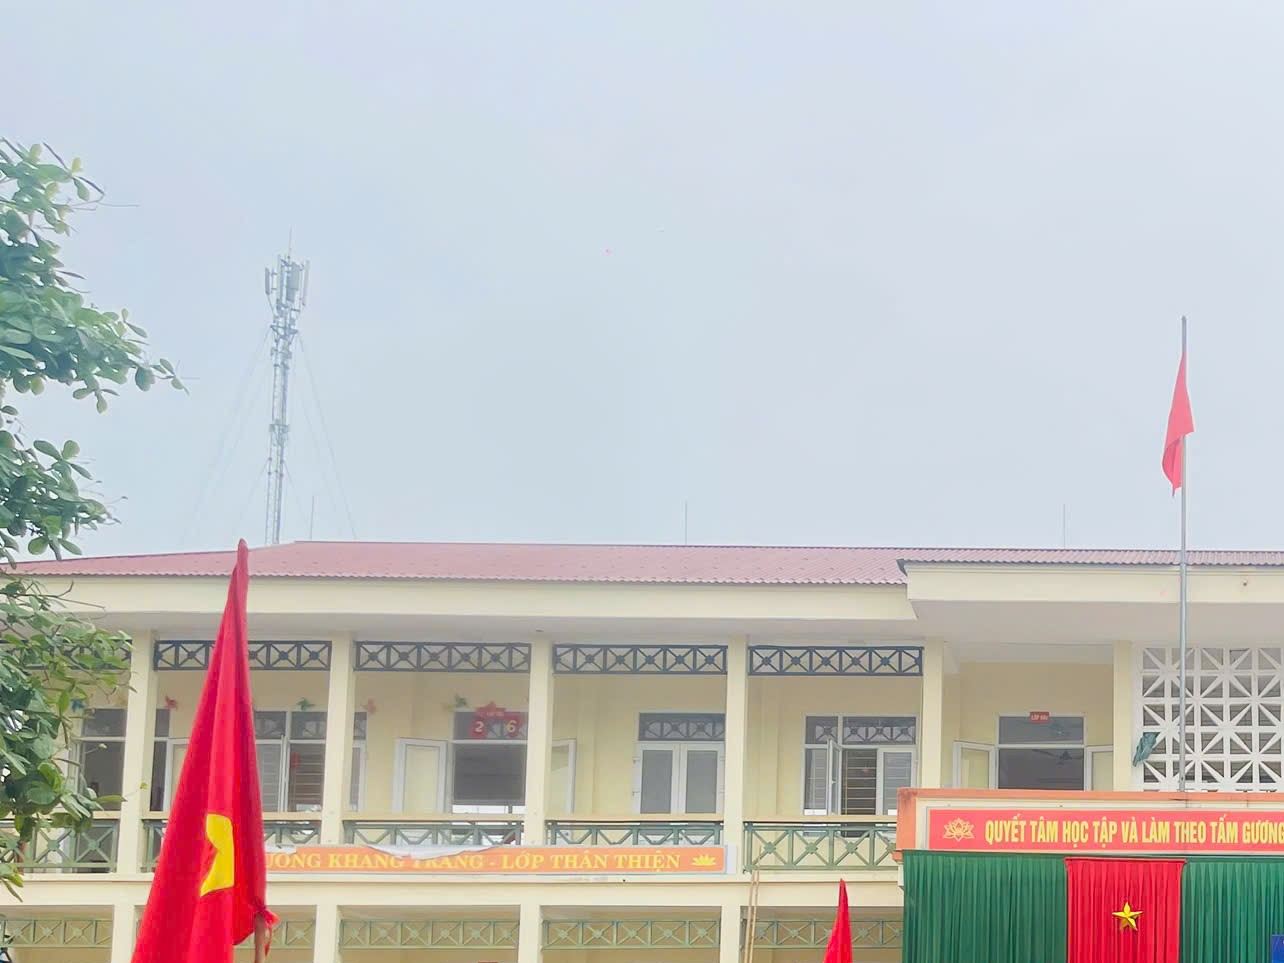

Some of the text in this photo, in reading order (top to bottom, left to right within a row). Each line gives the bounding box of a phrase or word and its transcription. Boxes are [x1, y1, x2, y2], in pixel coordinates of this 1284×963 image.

[475, 720, 517, 733] 2 6
[985, 814, 1026, 845] QUYẾT
[1030, 816, 1058, 843] TÂM
[1062, 820, 1089, 848] HỌC
[1092, 816, 1117, 848] TẬP
[1121, 816, 1139, 844] VÀ
[1142, 816, 1170, 844] LÀM
[1174, 820, 1206, 844] THEO
[1210, 814, 1239, 844] TẤM
[502, 851, 545, 869] LỚP
[550, 850, 610, 869] THÂN
[614, 850, 680, 872] THIỆN
